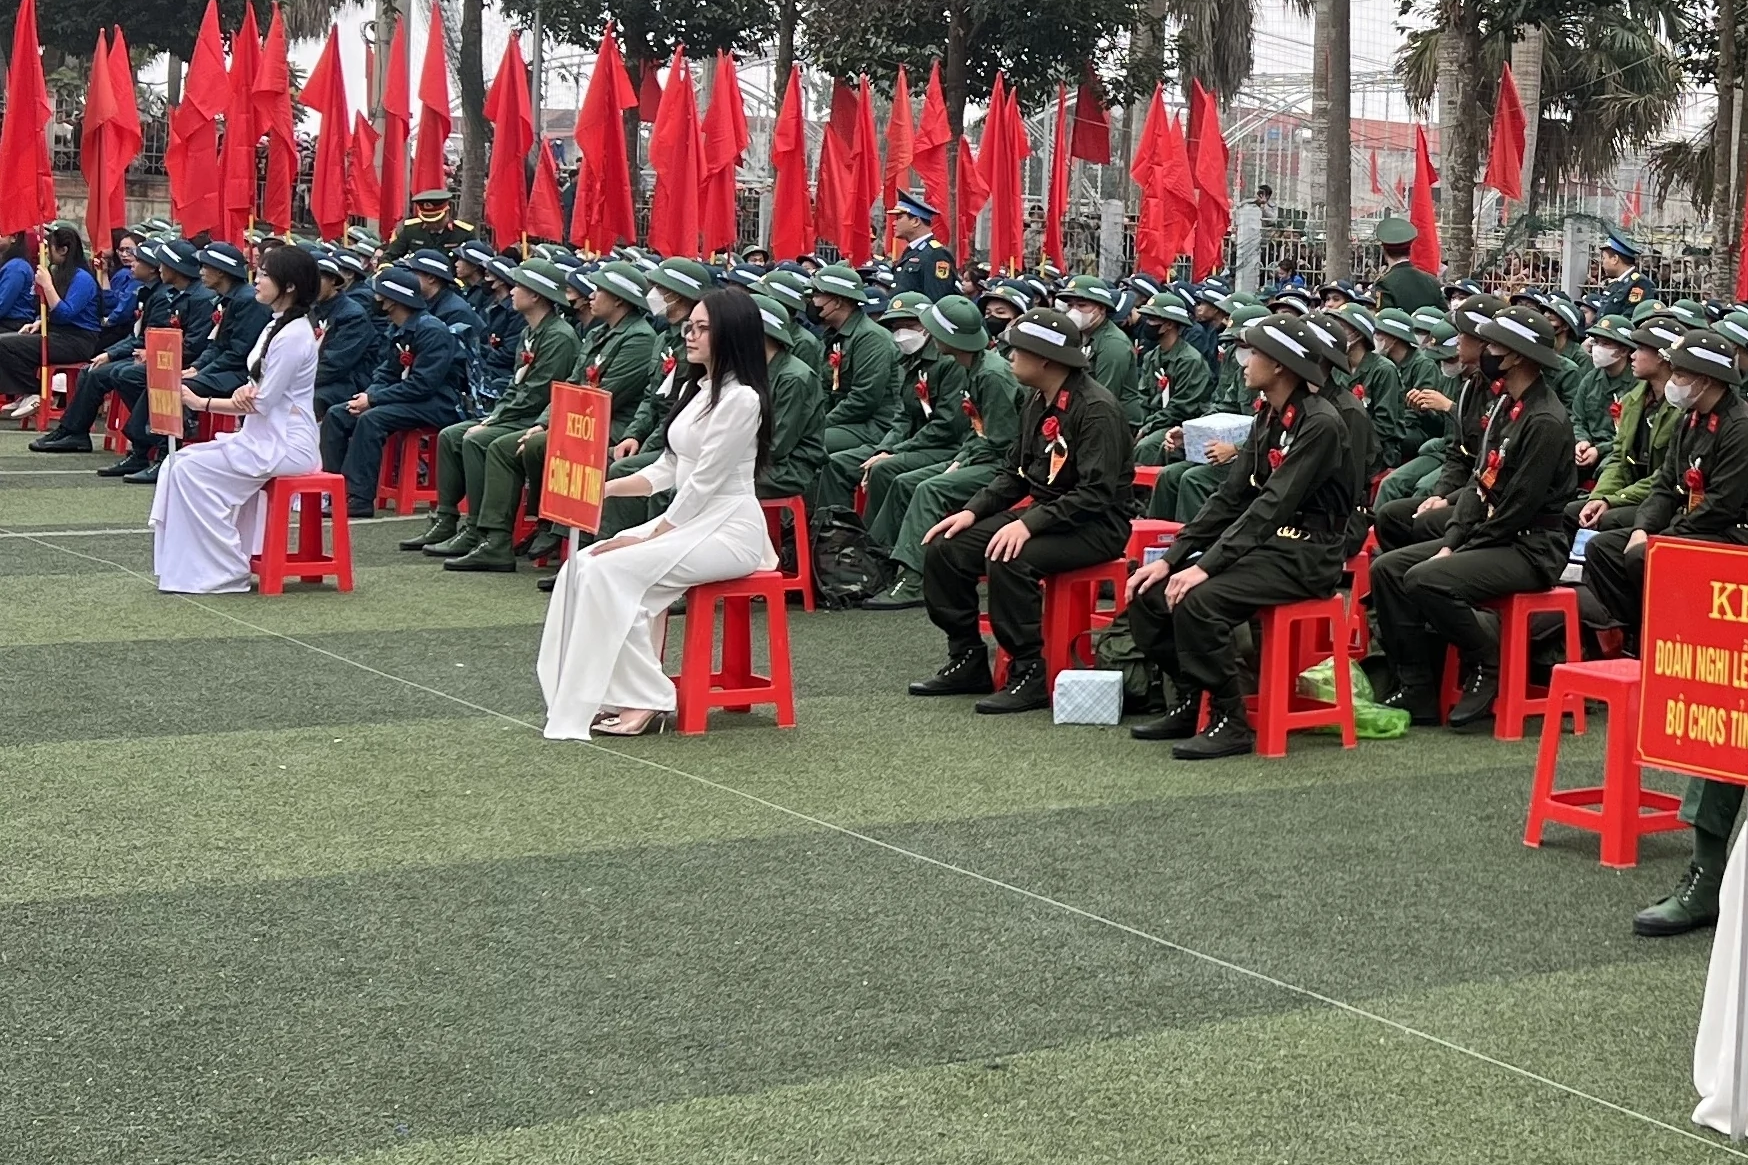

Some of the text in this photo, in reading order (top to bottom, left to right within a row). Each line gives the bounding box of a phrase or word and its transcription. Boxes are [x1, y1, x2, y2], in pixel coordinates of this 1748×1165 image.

[565, 405, 597, 442] KHỐI
[569, 462, 584, 501] AN
[1655, 634, 1693, 680] ĐOÀN
[1695, 645, 1730, 685] NGHI
[1665, 693, 1686, 746] BỘ
[1688, 702, 1727, 748] CHQS
